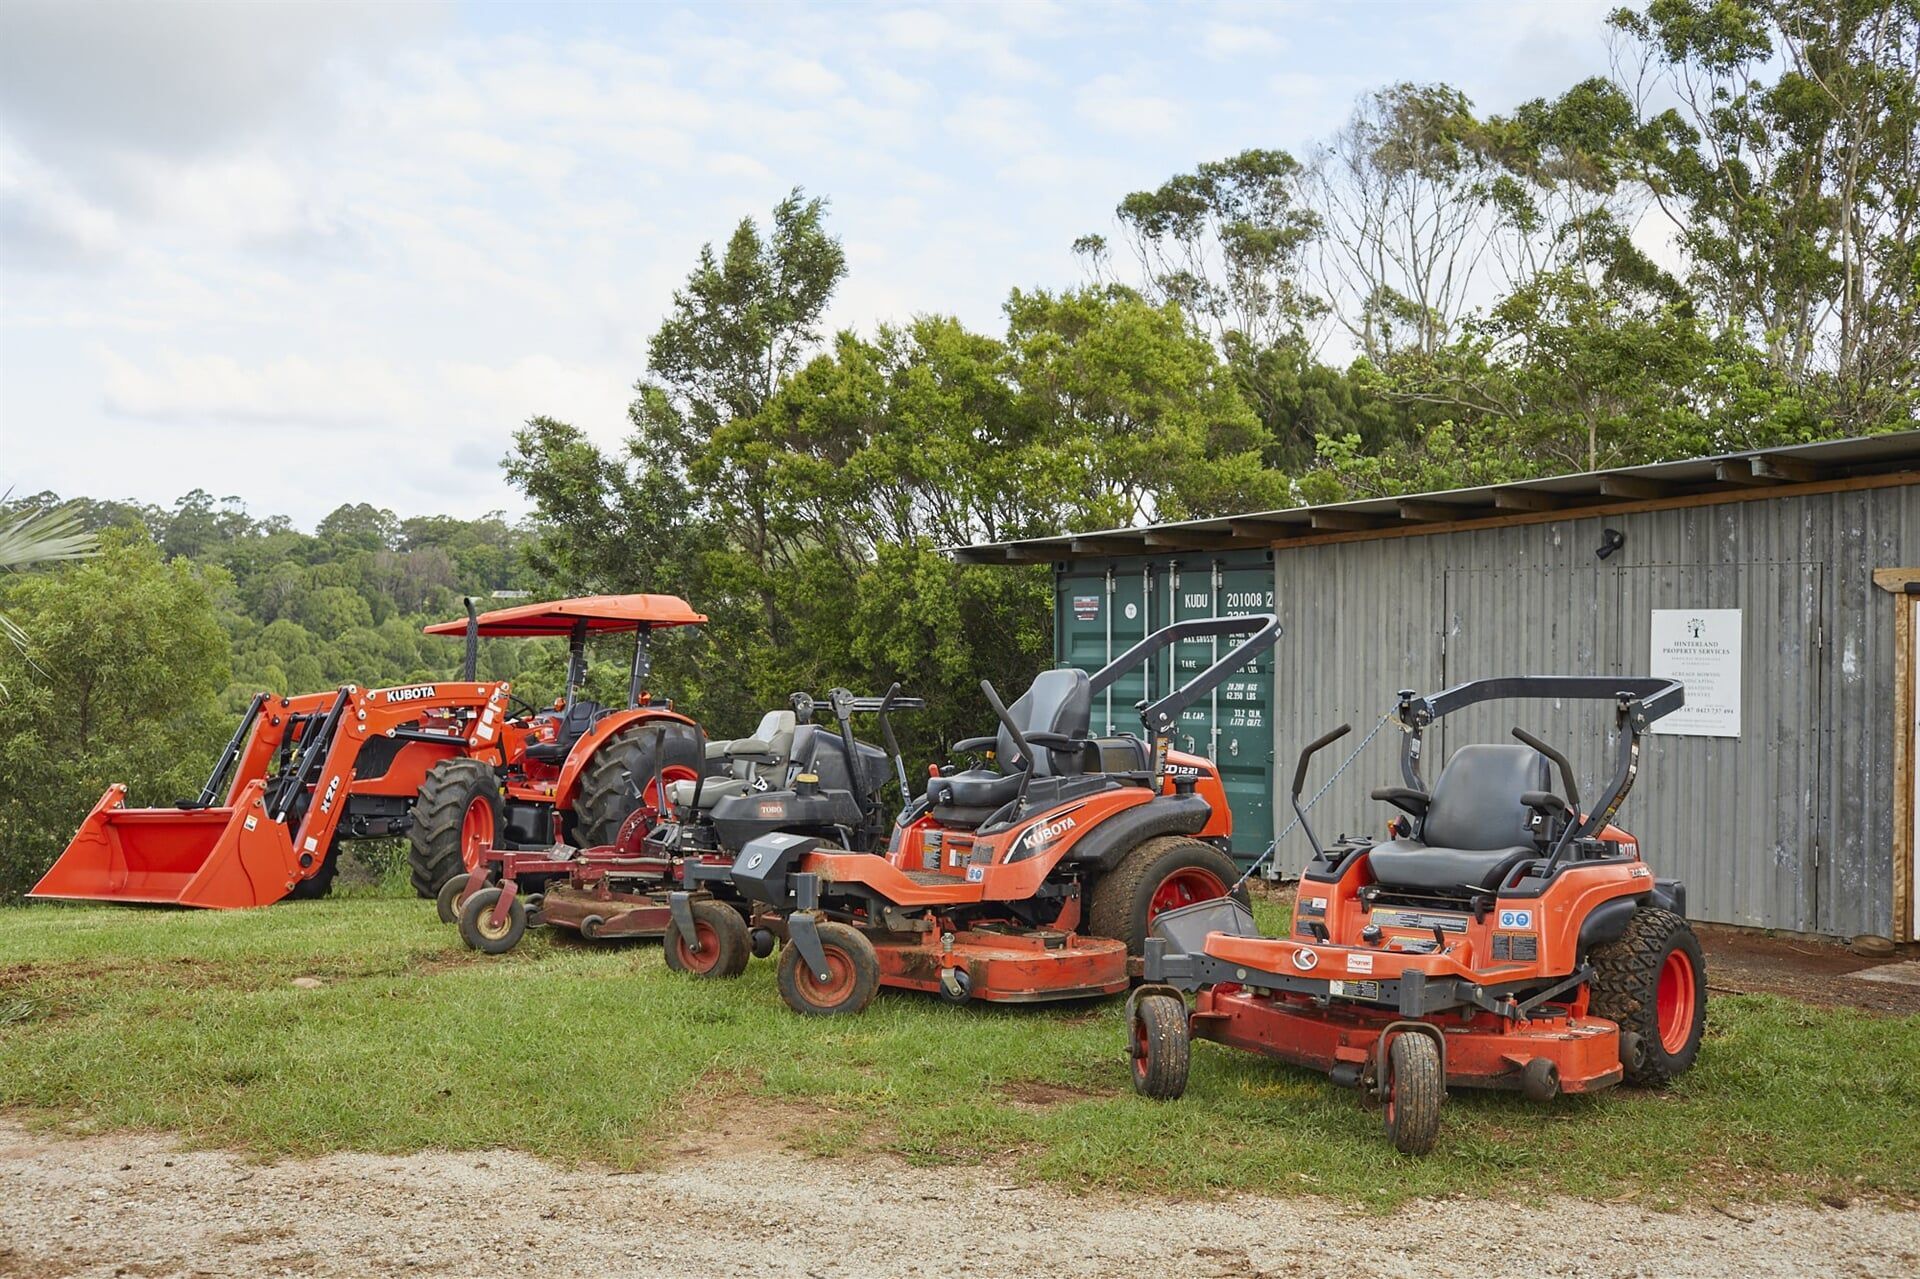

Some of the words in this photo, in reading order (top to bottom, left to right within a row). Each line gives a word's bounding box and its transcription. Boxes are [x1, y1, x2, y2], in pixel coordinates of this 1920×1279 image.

[1184, 593, 1208, 608] KUDU
[1226, 592, 1262, 607] 201008
[1266, 592, 1273, 607] 2
[387, 686, 435, 702] KUBOTA
[1246, 692, 1257, 700] LBS
[1023, 817, 1076, 850] KUBOTA
[1618, 842, 1637, 857] BOTA
